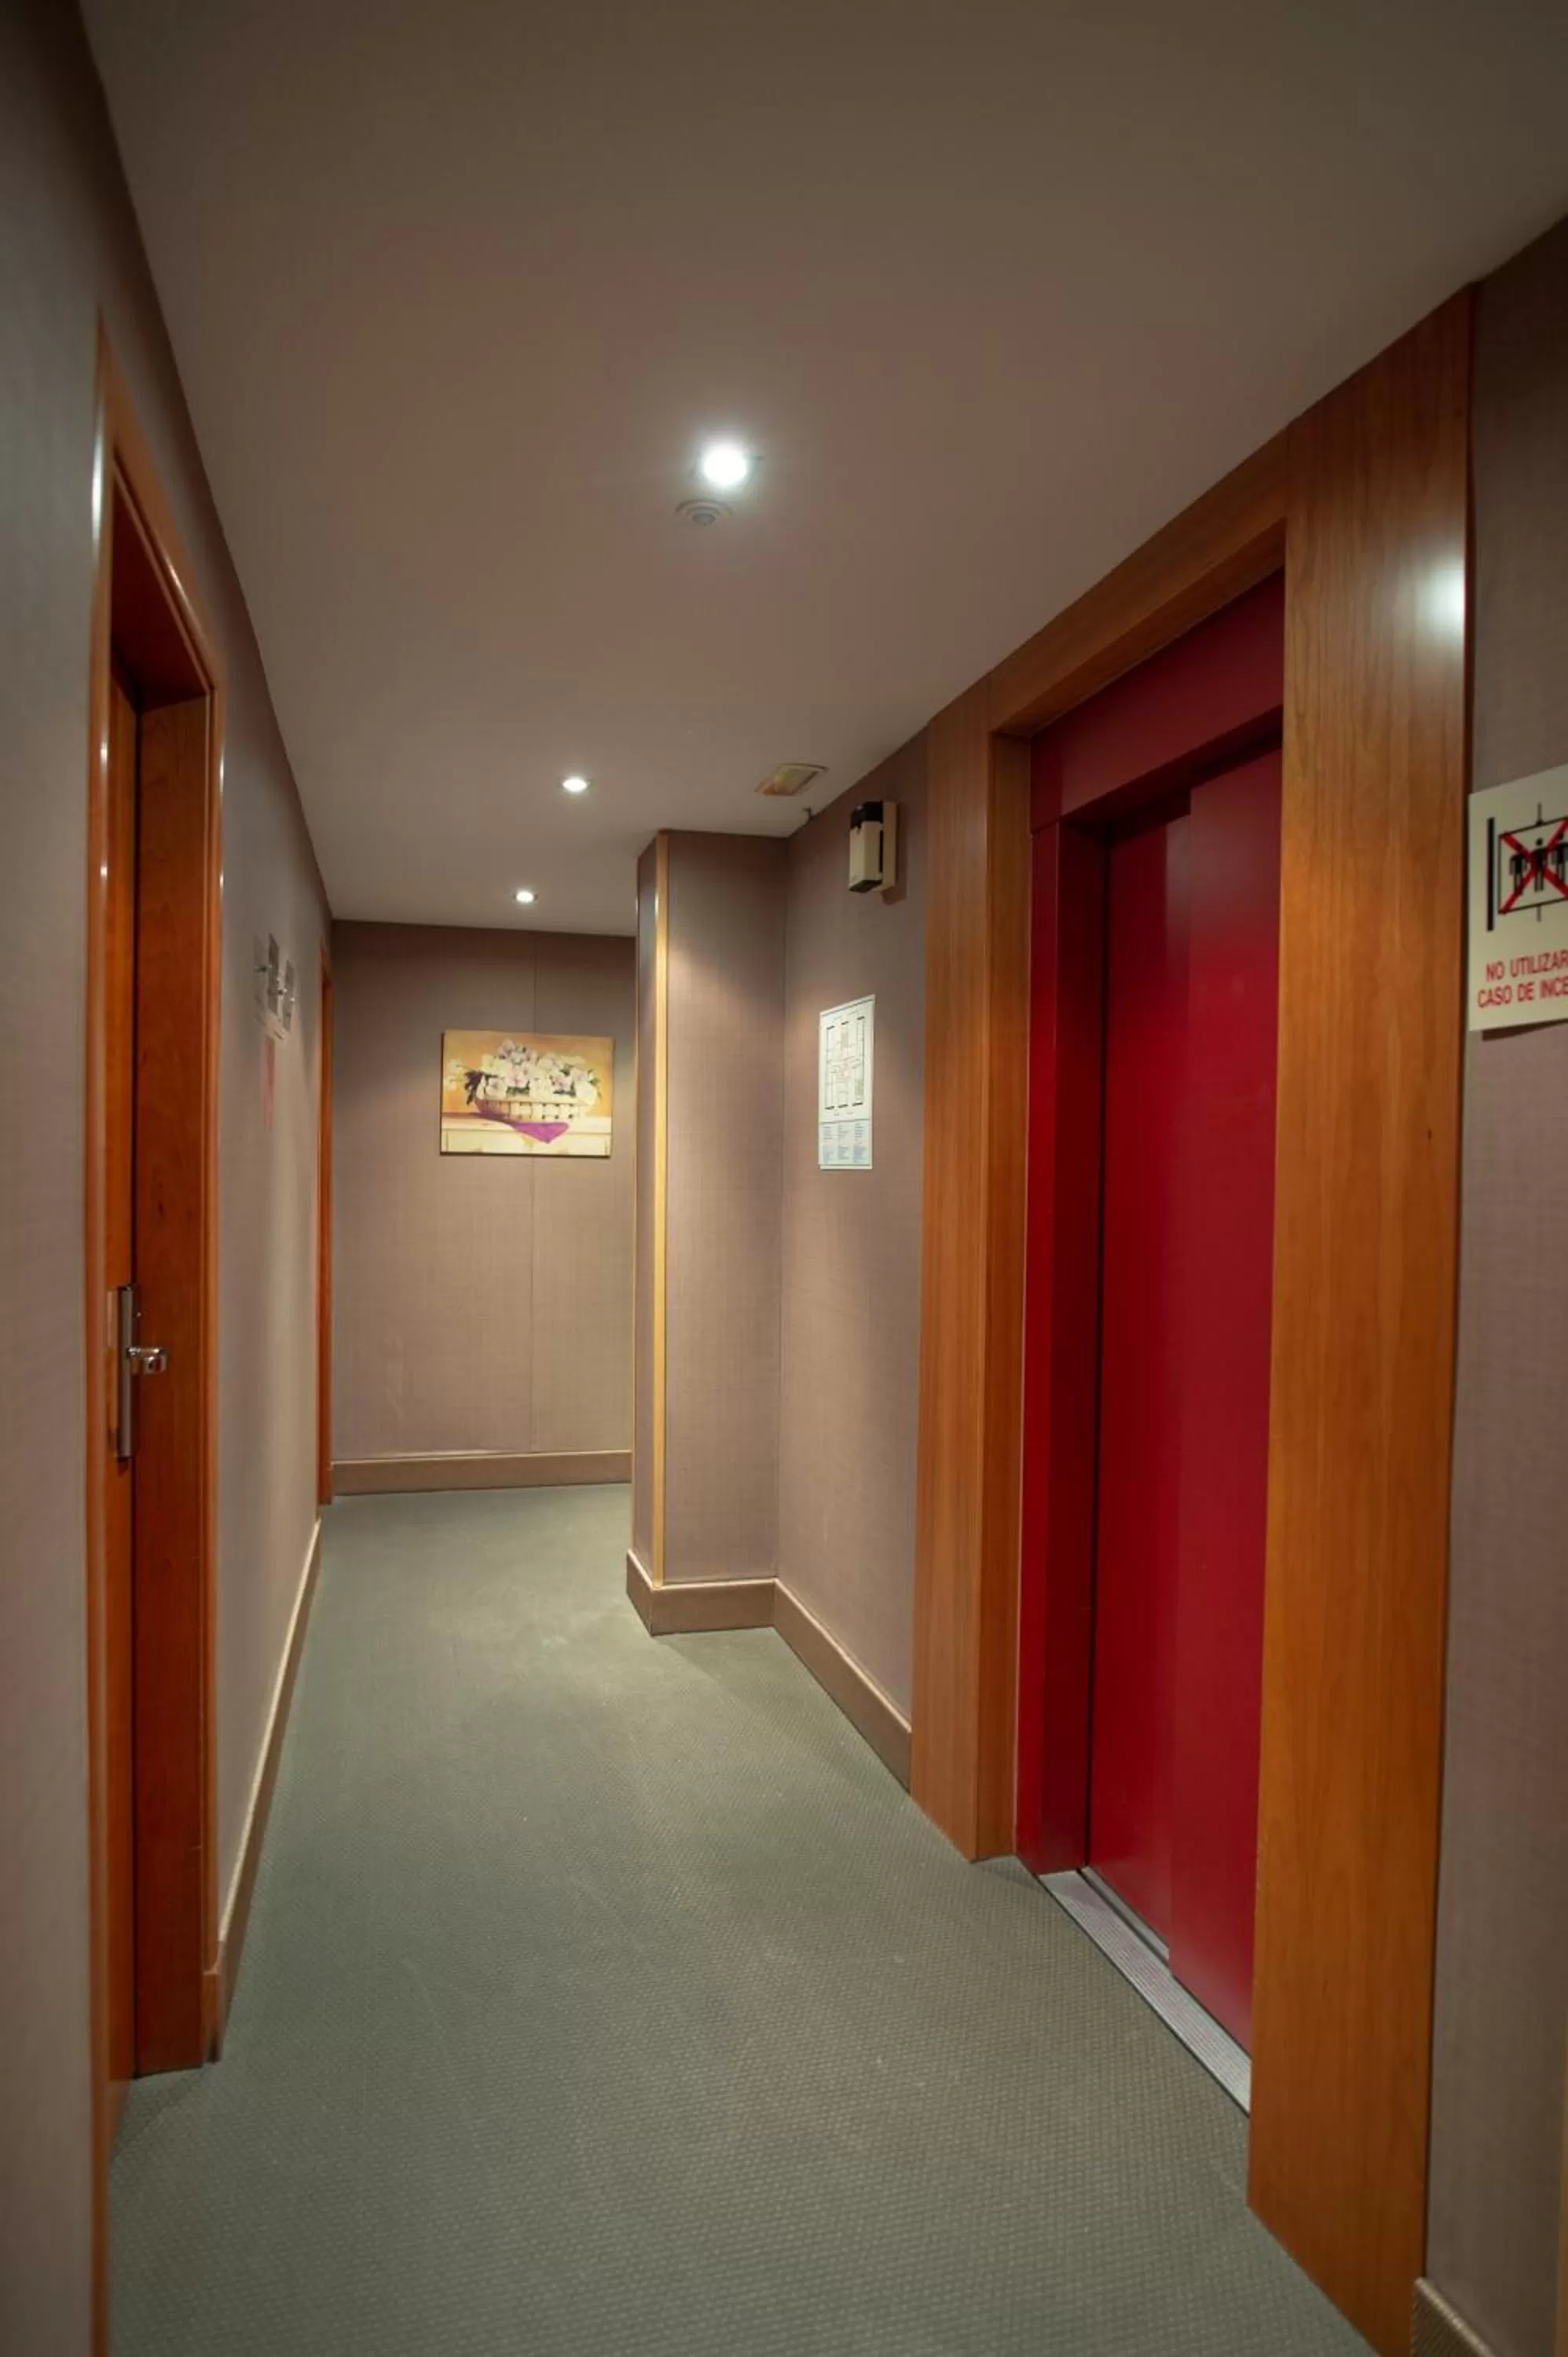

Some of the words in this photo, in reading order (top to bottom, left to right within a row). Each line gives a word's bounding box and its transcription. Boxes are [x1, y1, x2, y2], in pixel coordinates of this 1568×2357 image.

[1486, 961, 1505, 982] NO
[1510, 949, 1568, 977] UTILIZAR
[1477, 985, 1513, 1008] CASO
[1517, 982, 1535, 1002] DE
